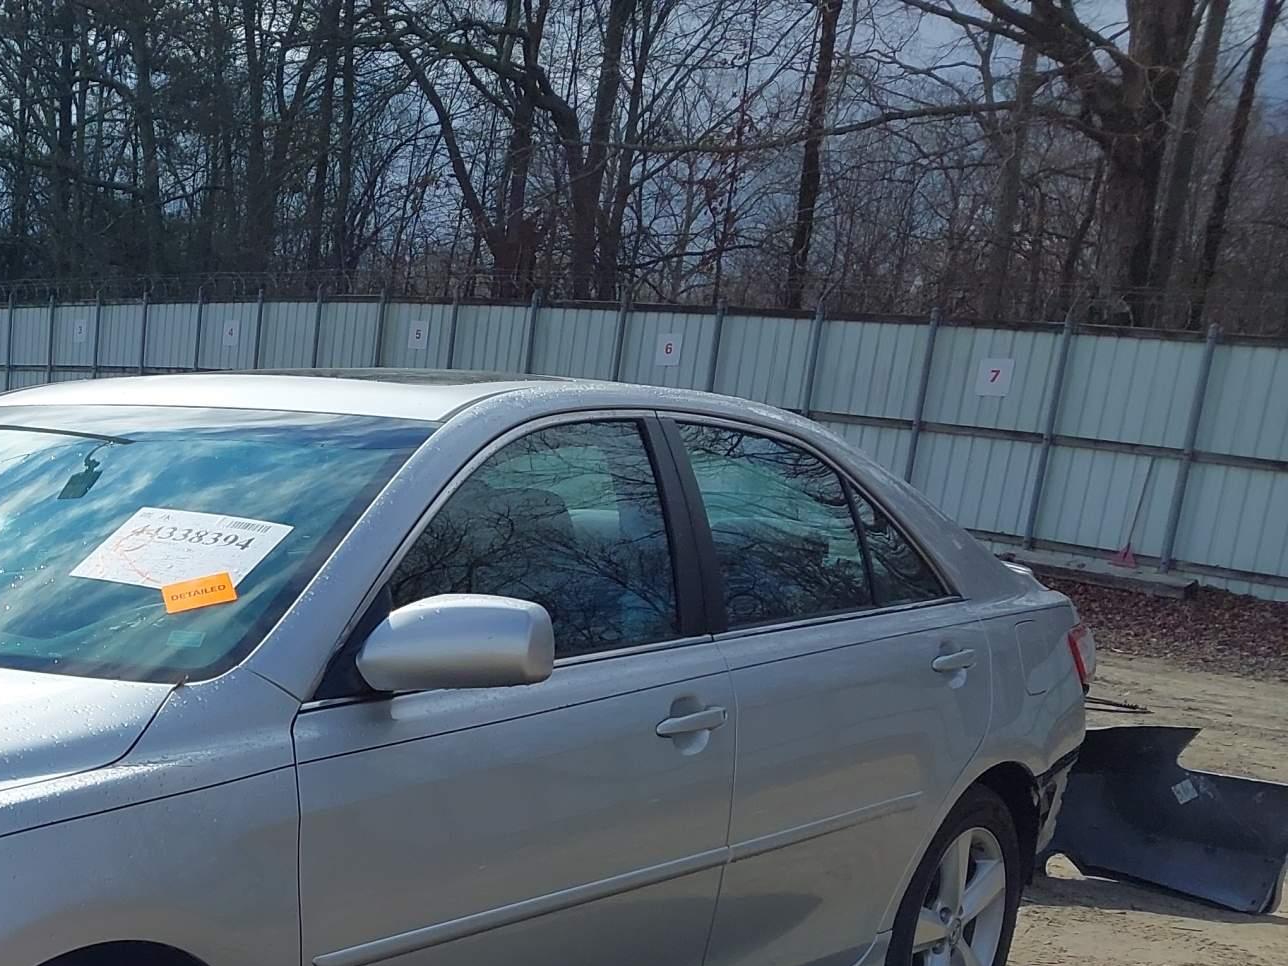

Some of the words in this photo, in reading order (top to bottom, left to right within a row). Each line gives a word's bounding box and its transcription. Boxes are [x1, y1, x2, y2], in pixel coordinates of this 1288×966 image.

[415, 329, 422, 340] 5
[665, 342, 673, 355] 6
[989, 369, 1001, 383] 7
[170, 584, 226, 601] DETAILED
